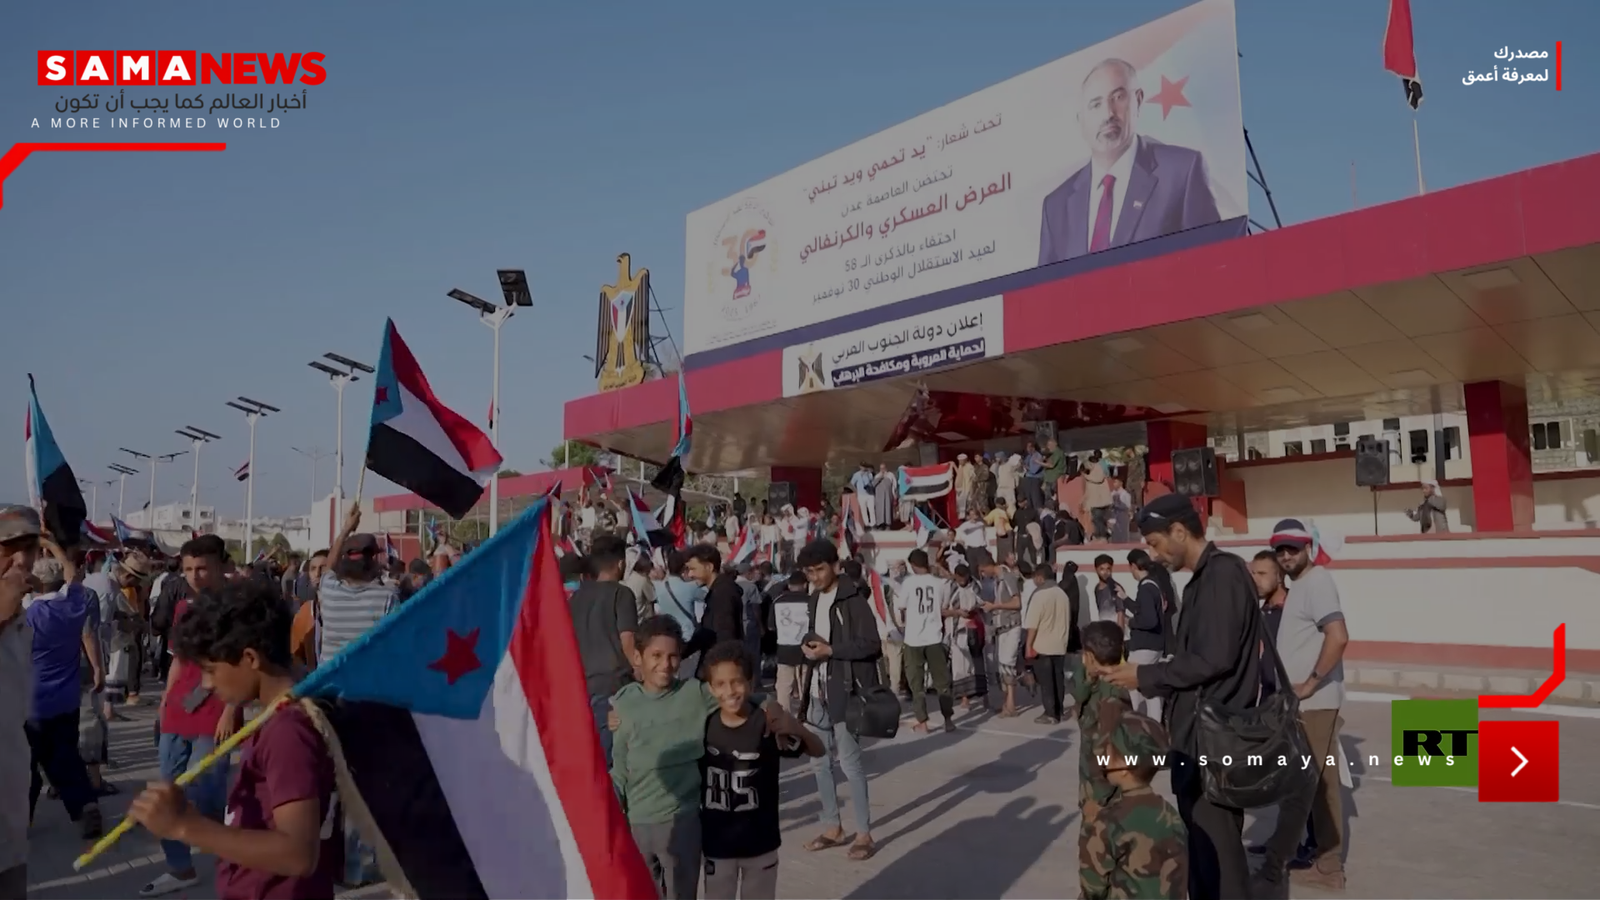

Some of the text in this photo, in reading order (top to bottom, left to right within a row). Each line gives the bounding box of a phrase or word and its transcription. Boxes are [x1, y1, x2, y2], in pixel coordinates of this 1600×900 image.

[973, 112, 1002, 135] تحت
[843, 168, 863, 187] ويد
[867, 148, 905, 181] تحمي
[866, 180, 909, 206] العاصمة
[955, 172, 1012, 211] العرض
[878, 193, 948, 239] العسكري
[799, 221, 874, 264] والكرنفالي
[919, 228, 956, 251] احتفاء
[968, 240, 996, 262] لعيد
[907, 249, 964, 280] الاستقلال
[847, 278, 860, 292] 30
[863, 267, 905, 291] الوطني
[831, 312, 984, 366] إعلان دولة الجنوب العربي
[948, 339, 985, 361] لحماية
[1403, 730, 1478, 756] RT
